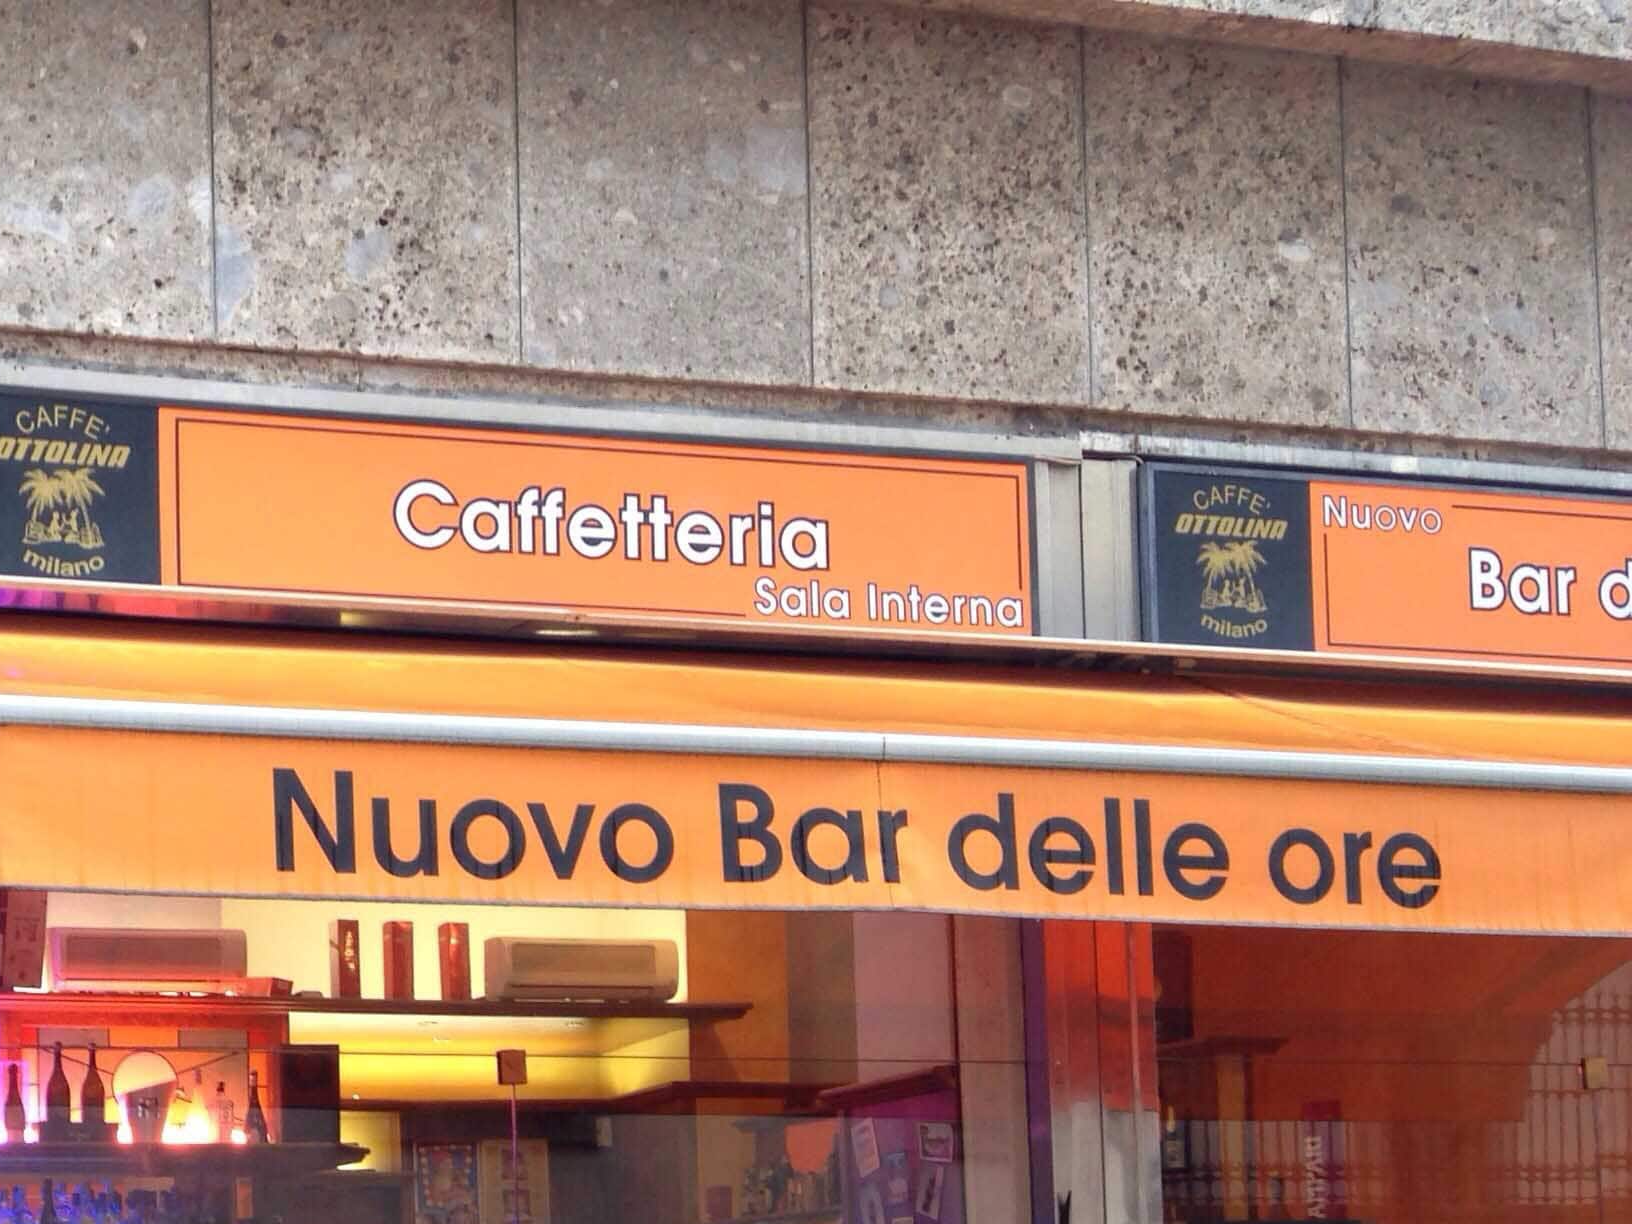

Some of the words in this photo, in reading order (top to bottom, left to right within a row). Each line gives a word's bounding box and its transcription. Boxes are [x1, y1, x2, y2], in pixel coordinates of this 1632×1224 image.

[392, 479, 830, 570] Caffetteria
[1174, 512, 1288, 541] OTTOLINA
[1321, 495, 1443, 534] Nuovo
[23, 549, 105, 577] milano
[1468, 546, 1577, 616] Bar
[754, 577, 851, 619] Sala
[868, 583, 1025, 628] Interna
[1200, 612, 1268, 640] milano
[271, 766, 675, 883] Nuovo
[718, 783, 907, 885] Bar
[947, 793, 1230, 901] delle
[1268, 826, 1443, 911] ore
